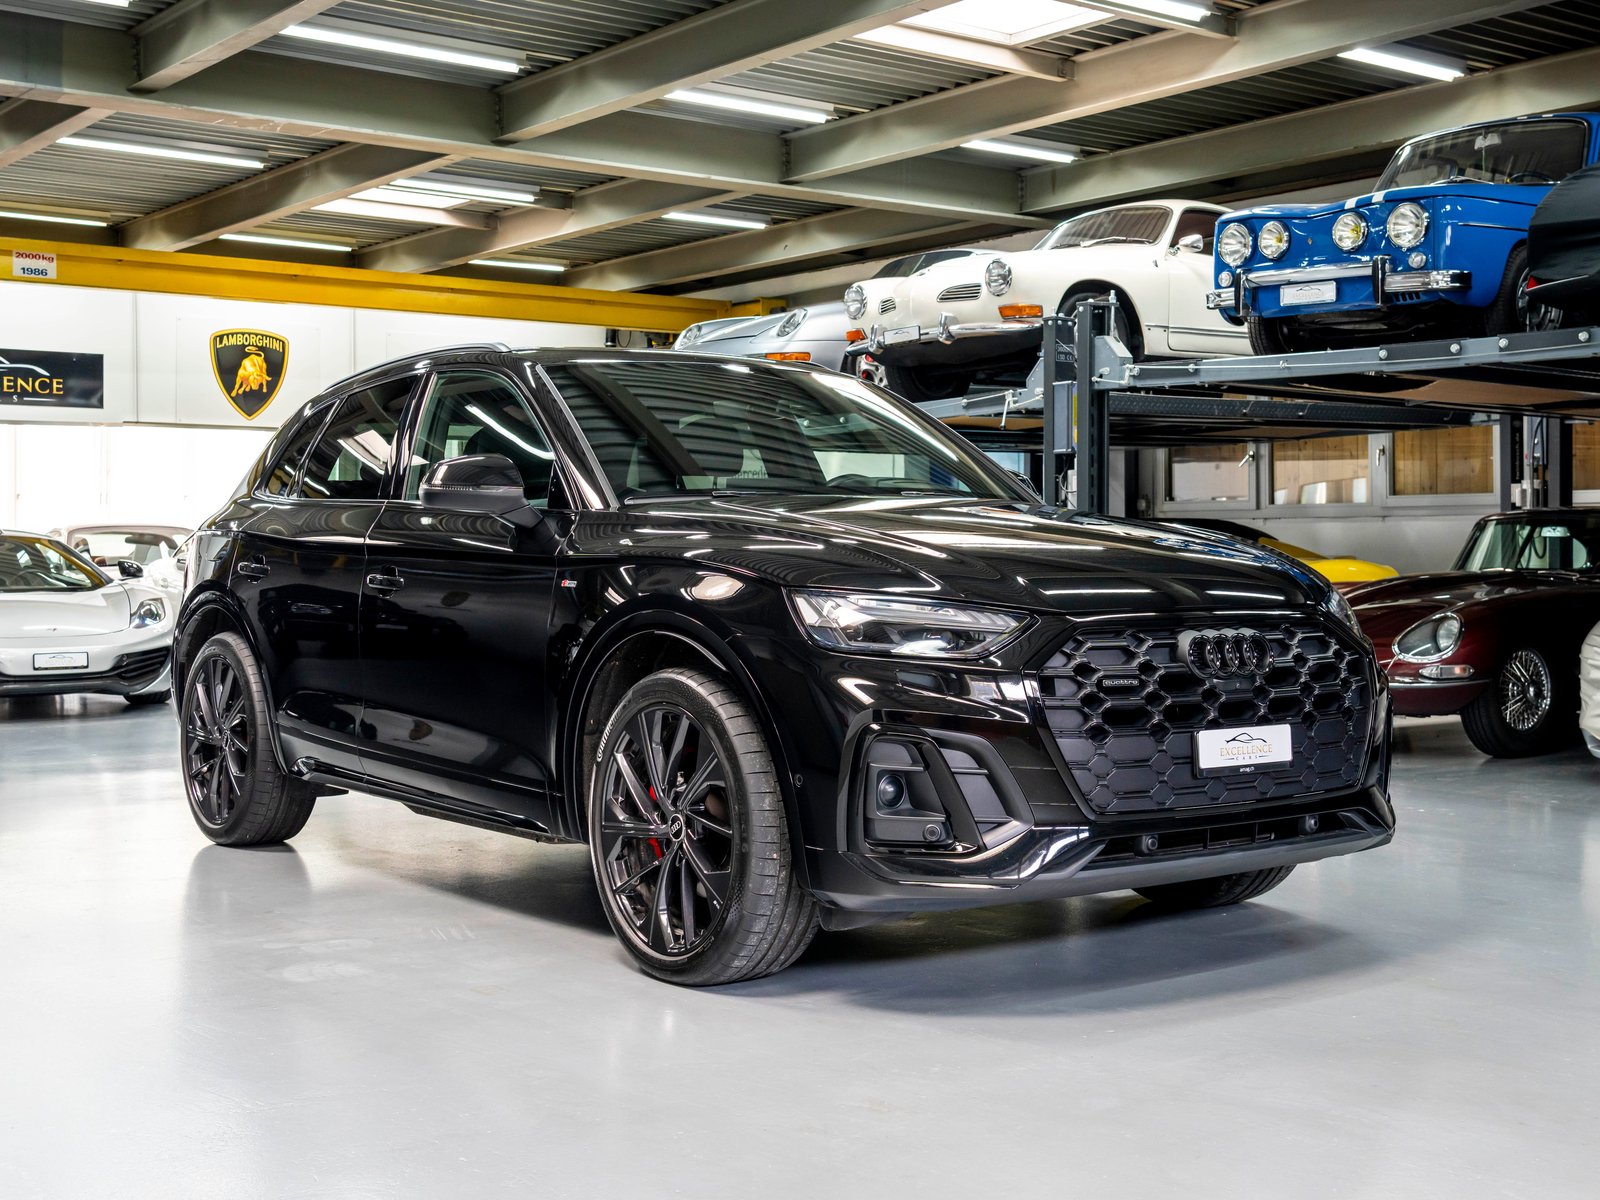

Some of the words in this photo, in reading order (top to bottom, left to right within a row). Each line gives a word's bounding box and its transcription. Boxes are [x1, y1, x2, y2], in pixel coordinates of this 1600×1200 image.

[20, 267, 48, 276] 1986
[216, 333, 283, 353] LAMBORGHINI
[1220, 744, 1273, 757] EXCELLENCE
